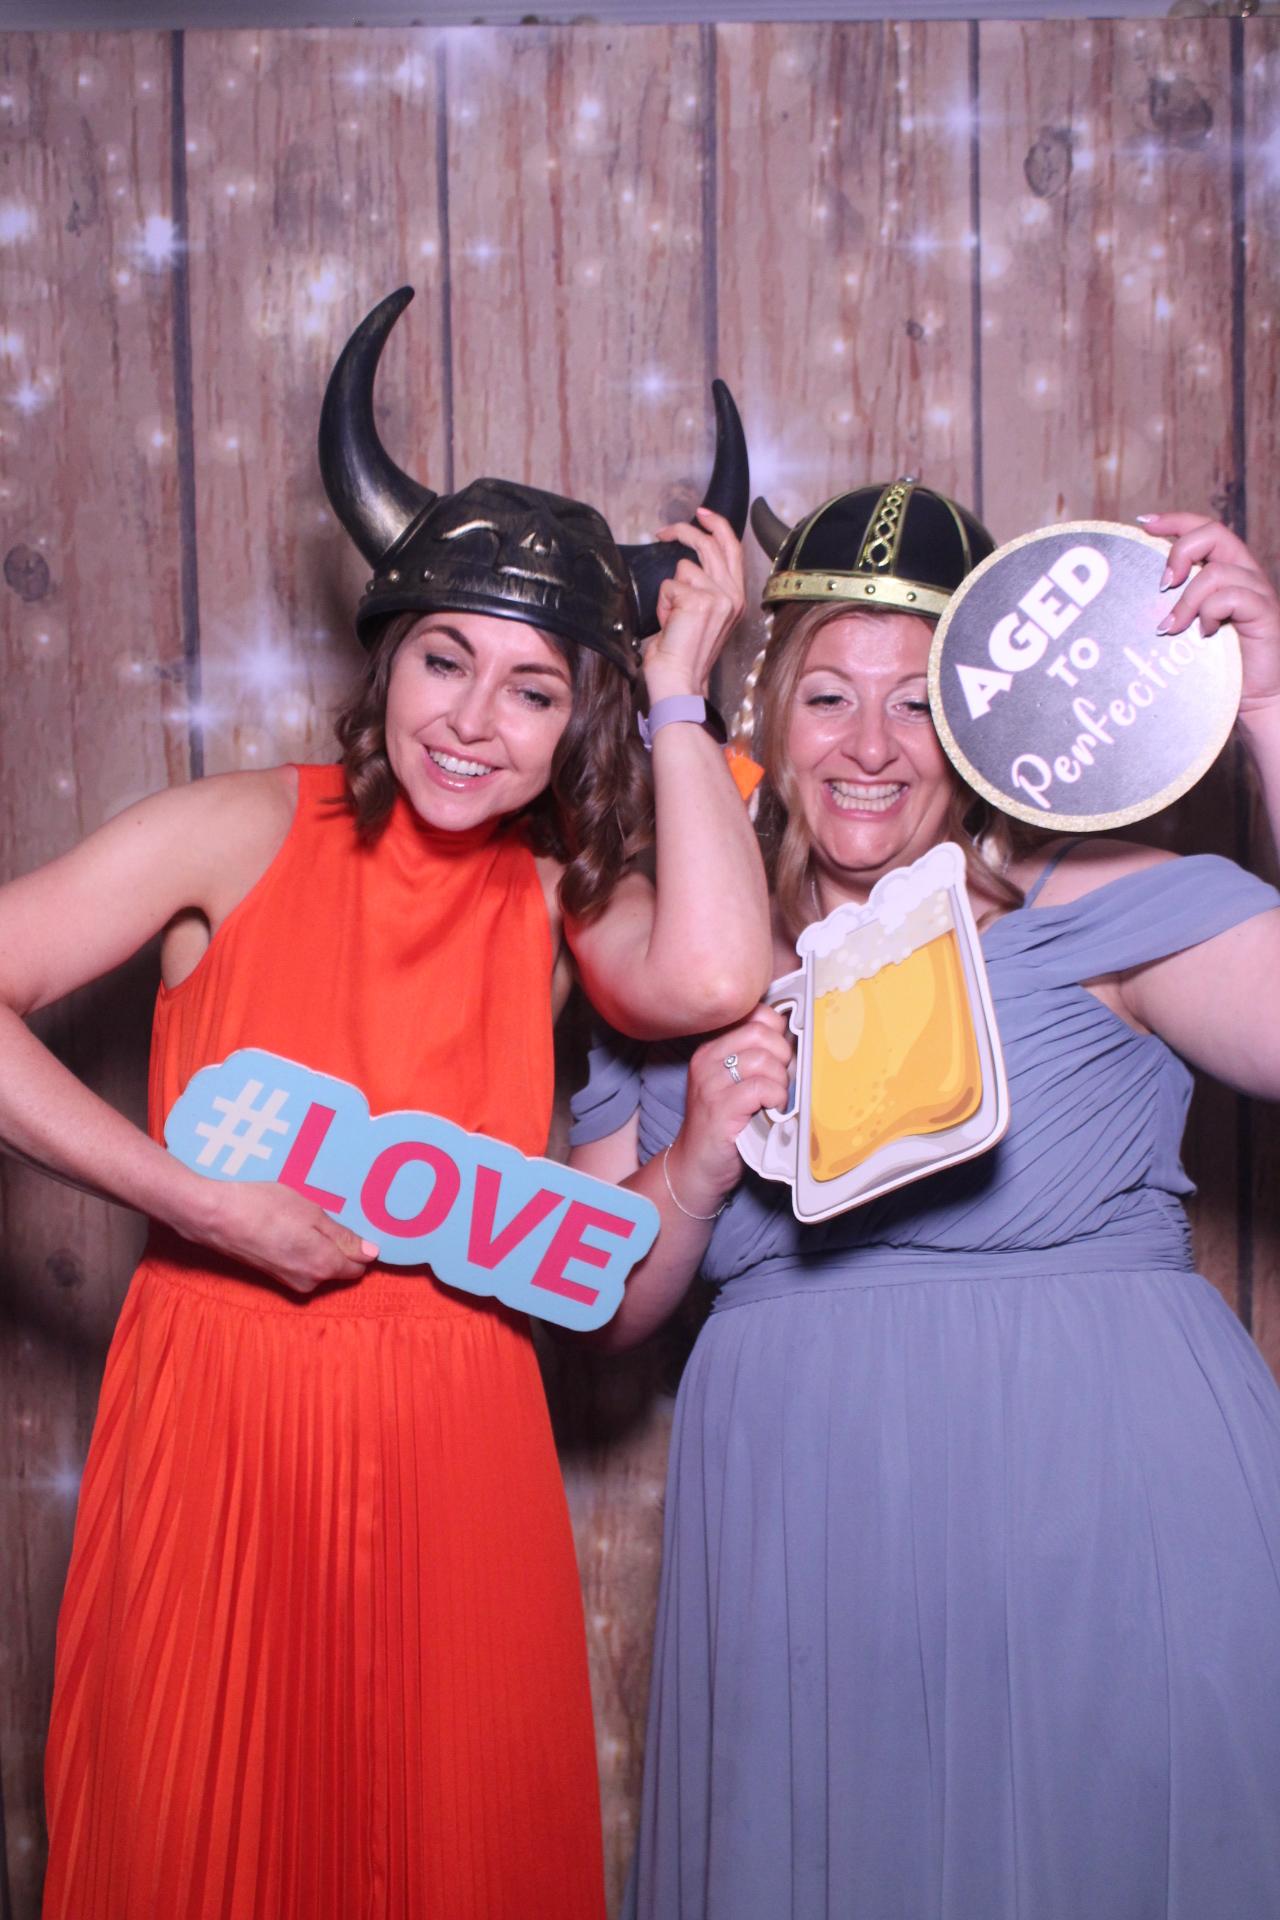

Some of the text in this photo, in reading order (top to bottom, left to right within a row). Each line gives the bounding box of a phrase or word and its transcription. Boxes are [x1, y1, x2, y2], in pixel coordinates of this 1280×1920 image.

[955, 546, 1111, 721] AGED
[1046, 637, 1100, 688] TO
[195, 1079, 637, 1307] #LOVE
